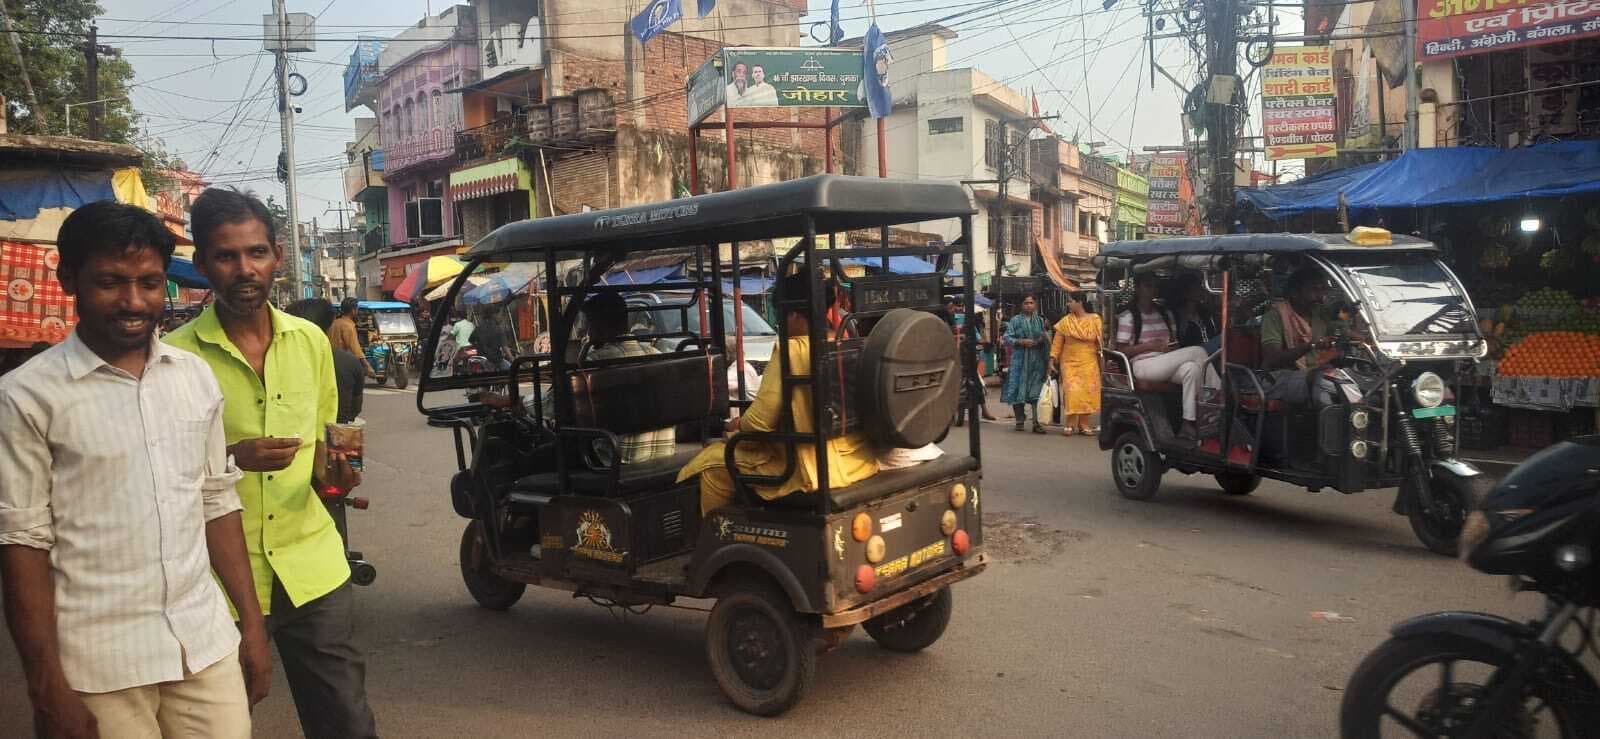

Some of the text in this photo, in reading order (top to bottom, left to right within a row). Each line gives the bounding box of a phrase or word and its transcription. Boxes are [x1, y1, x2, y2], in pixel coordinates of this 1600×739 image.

[1464, 9, 1516, 32] एवं
[1471, 29, 1521, 49] अंग्रेजी,
[1302, 47, 1329, 64] कार्ड
[781, 86, 849, 102] जोहार
[1264, 77, 1330, 95] शादी कार्ड
[1310, 131, 1334, 142] पोस्टर
